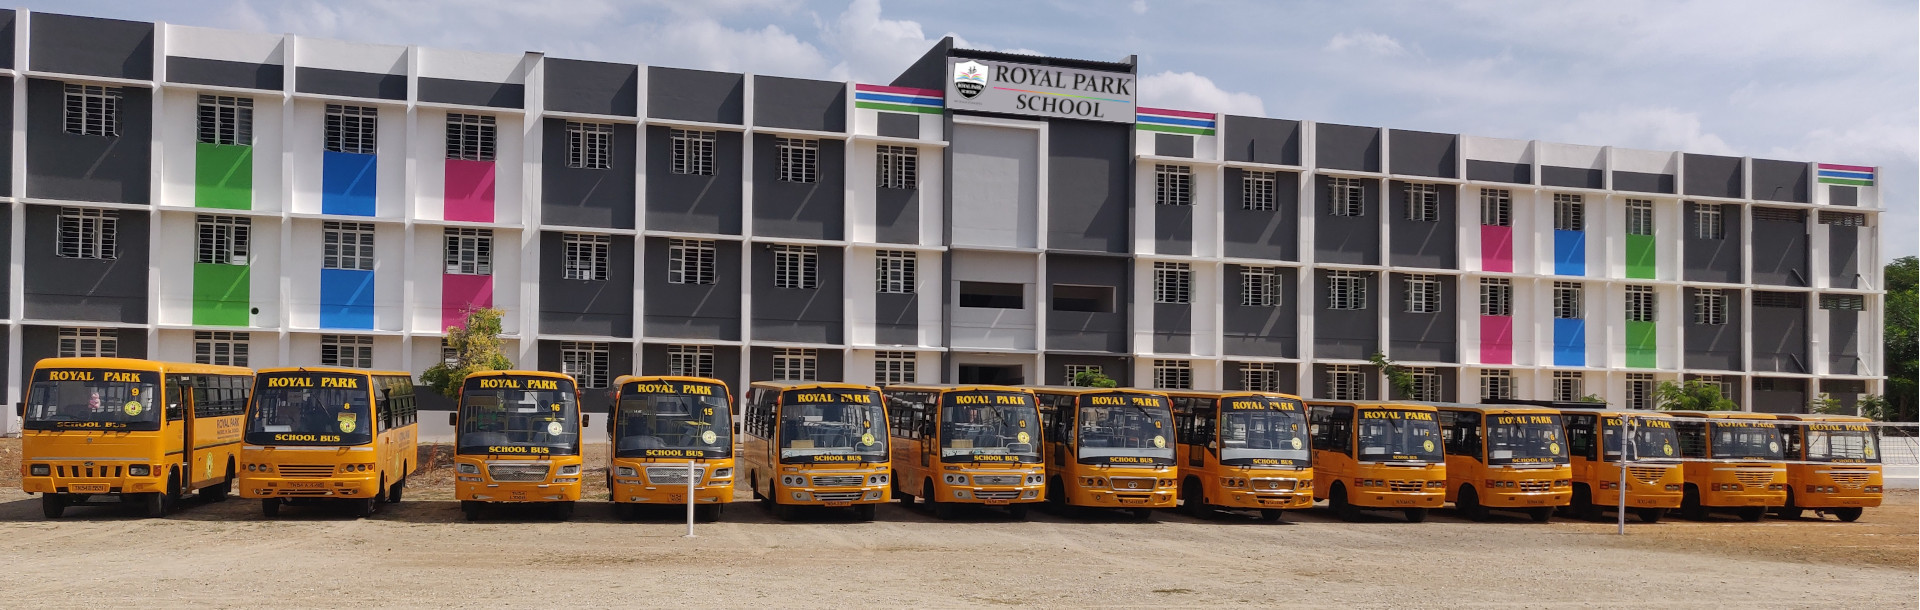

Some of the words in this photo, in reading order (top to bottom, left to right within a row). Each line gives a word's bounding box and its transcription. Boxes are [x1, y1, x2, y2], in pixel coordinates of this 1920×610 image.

[995, 65, 1066, 89] ROYAL
[1072, 73, 1131, 96] PARK
[1016, 94, 1104, 118] SCHOOL
[50, 371, 94, 381] ROYAL
[104, 372, 140, 383] PARK
[268, 377, 314, 388] ROYAL
[321, 378, 358, 388] PARK
[480, 379, 520, 388] ROYAL
[528, 380, 558, 390] PARK
[131, 387, 140, 396] 9
[638, 384, 676, 393] ROYAL
[683, 384, 712, 395] PARK
[798, 394, 834, 402] ROYAL
[956, 396, 991, 404] ROYAL
[997, 396, 1025, 405] PARK
[1092, 397, 1126, 405] ROYAL
[1132, 398, 1160, 407] PARK
[551, 404, 560, 412] 16
[1233, 402, 1264, 410] ROYAL
[704, 408, 713, 416] 15
[1364, 411, 1400, 419] ROYAL
[1405, 412, 1432, 420] PARK
[1530, 416, 1552, 424] PARK
[1607, 419, 1641, 427] ROAL
[1646, 420, 1671, 428] PARK
[275, 434, 317, 442] SCHOOL
[320, 434, 340, 442] BUS
